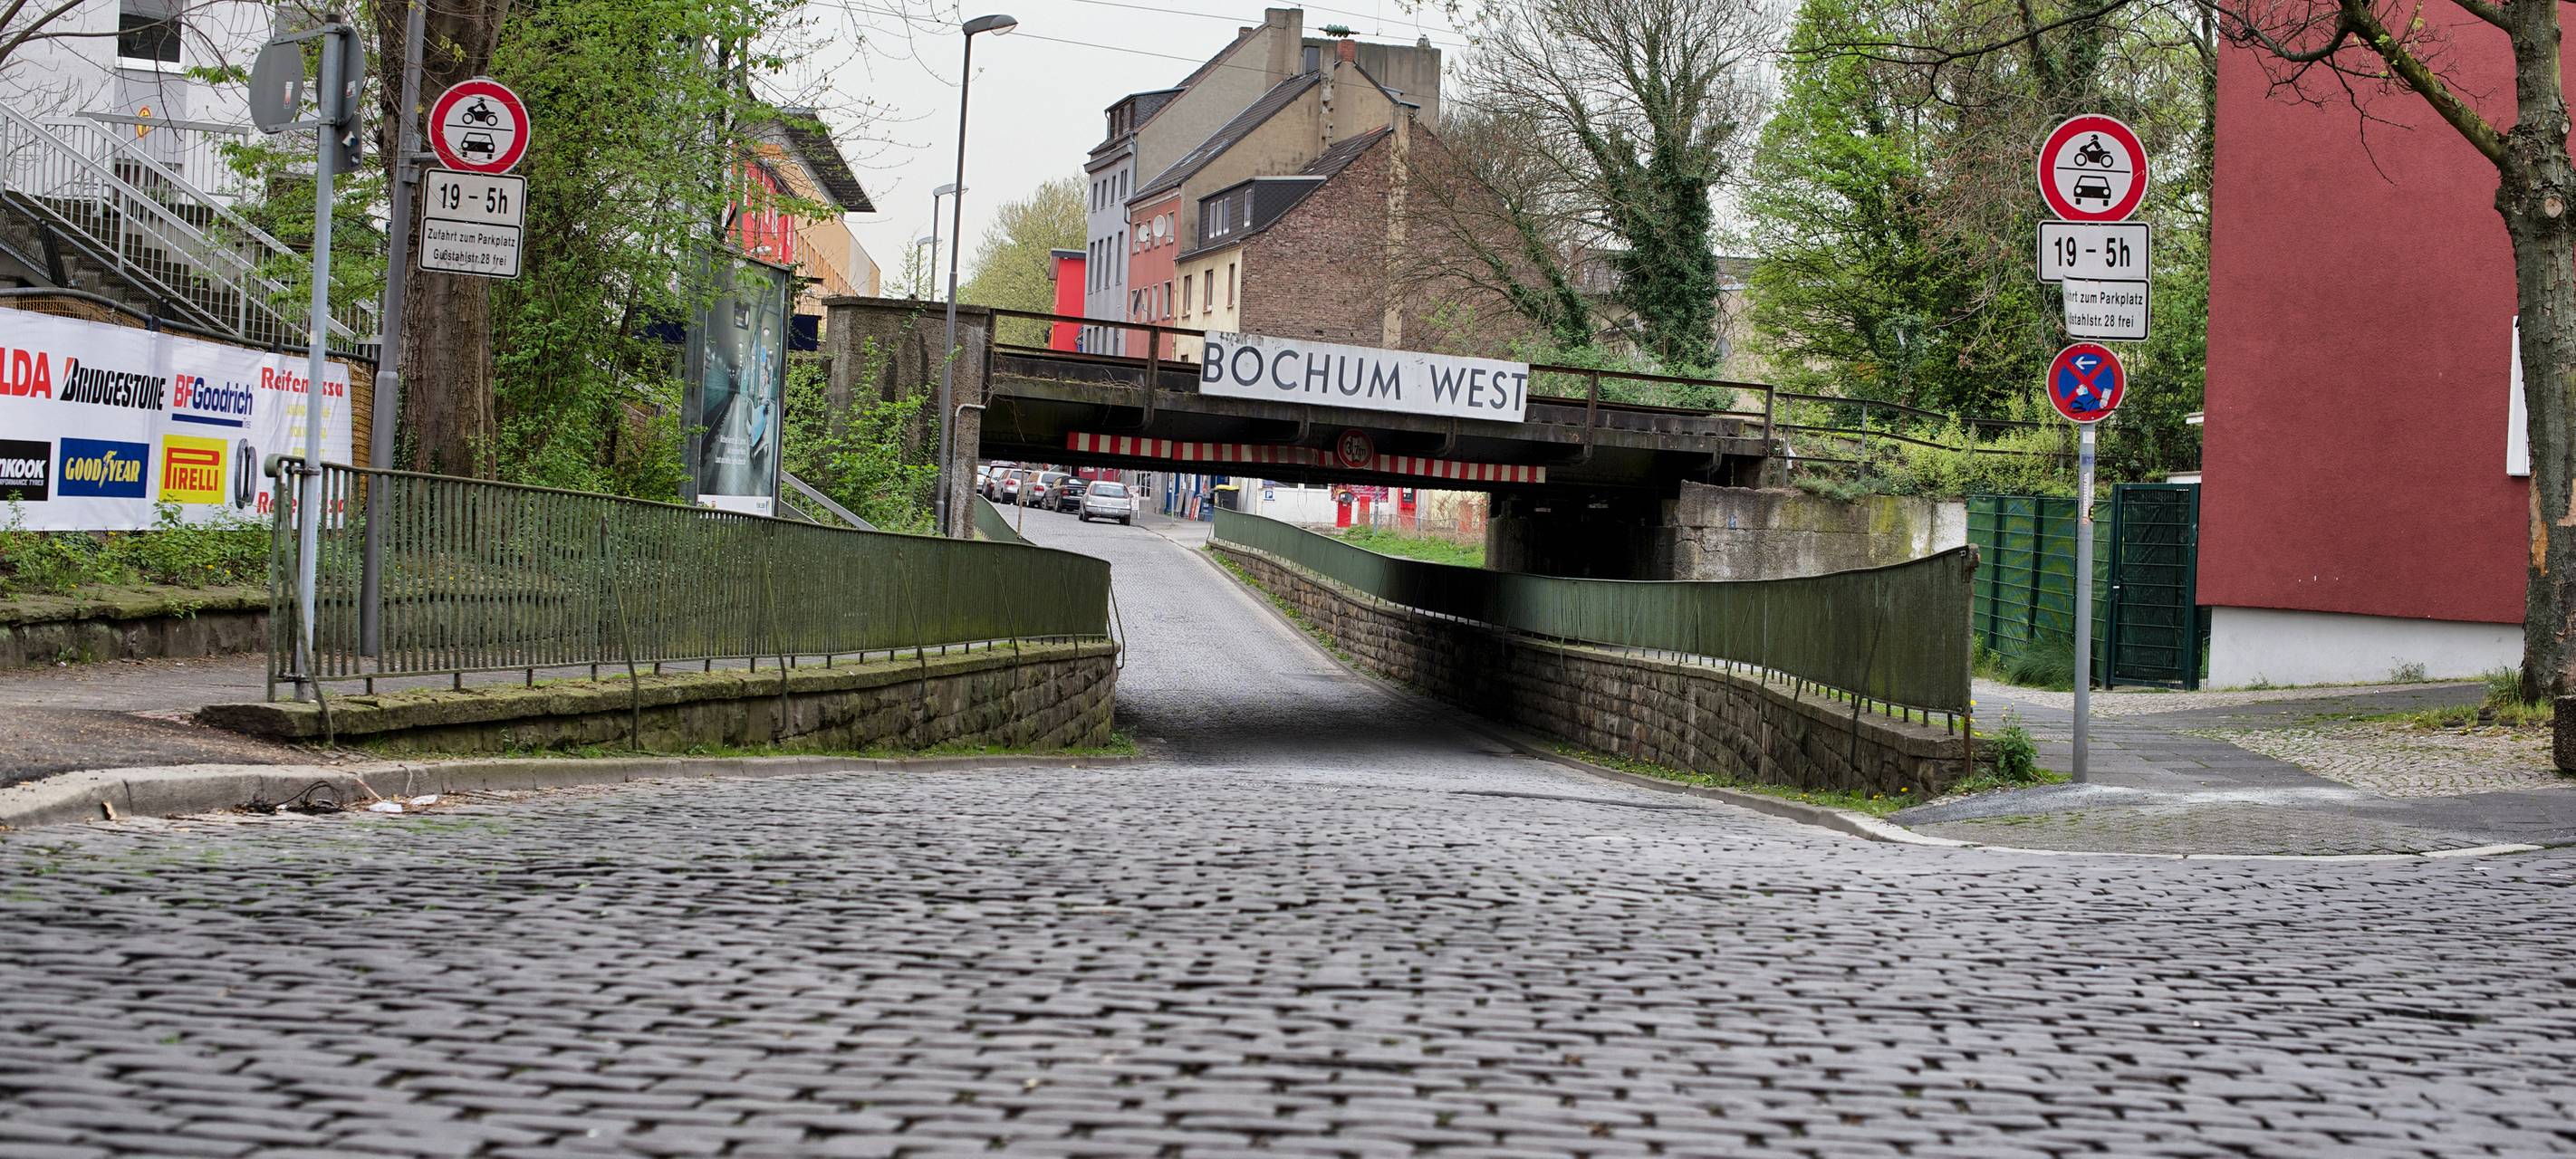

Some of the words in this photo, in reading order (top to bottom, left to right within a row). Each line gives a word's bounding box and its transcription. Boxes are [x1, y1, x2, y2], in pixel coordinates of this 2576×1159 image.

[440, 183, 460, 210] 19
[485, 187, 508, 214] 5h
[428, 227, 457, 242] Zufahrt
[459, 234, 476, 244] zum
[477, 233, 515, 247] Parkplatz
[2054, 236, 2077, 267] 19
[2105, 236, 2130, 268] 5h
[492, 254, 507, 266] frei
[2080, 292, 2098, 304] zum
[2100, 291, 2143, 307] Parkplatz
[2104, 314, 2115, 327] 28
[2118, 314, 2134, 328] frei
[60, 357, 166, 411] BRIDGESTONE
[1201, 340, 1402, 402] BOCHUM
[1428, 362, 1529, 412] WEST
[173, 373, 254, 416] BFGoodrich
[164, 446, 220, 492] PIRELLI
